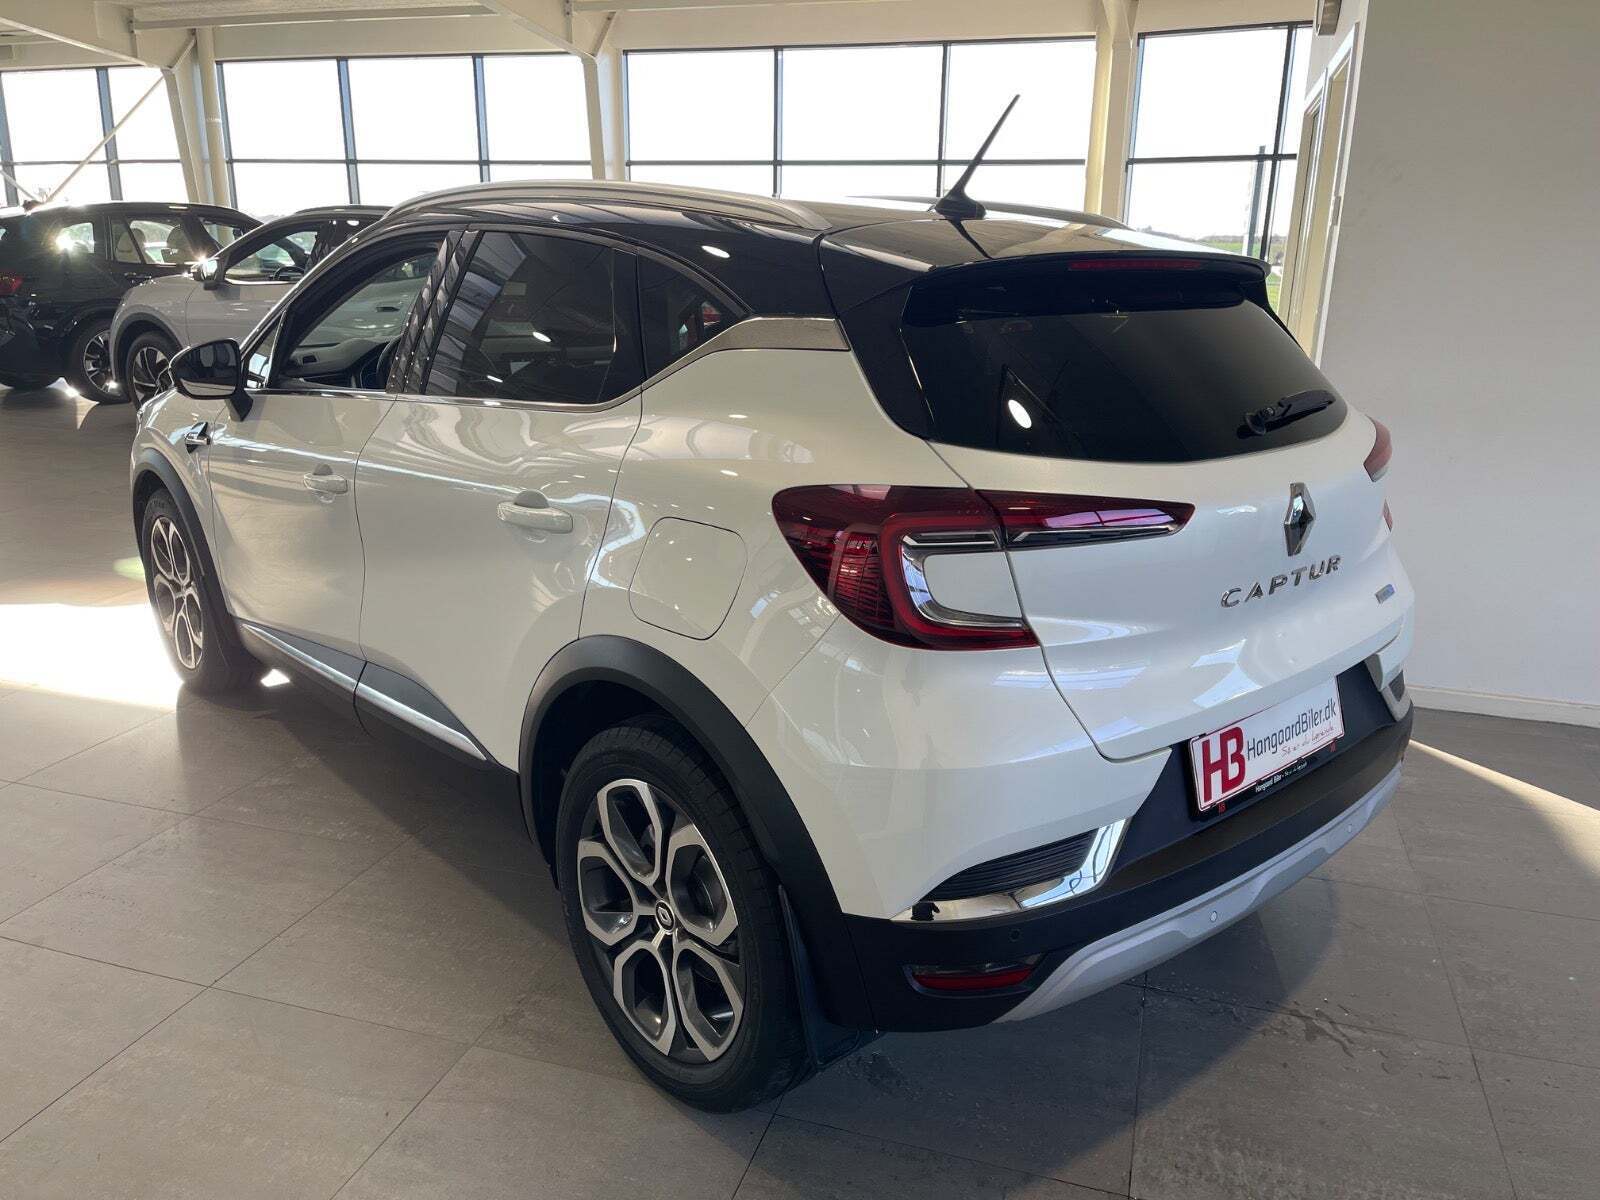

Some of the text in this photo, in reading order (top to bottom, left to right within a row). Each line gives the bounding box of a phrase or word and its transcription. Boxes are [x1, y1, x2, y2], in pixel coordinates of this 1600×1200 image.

[1221, 555, 1341, 608] CAPTUR
[1201, 726, 1246, 803] HB
[1247, 697, 1337, 761] HangaardBiler.dk
